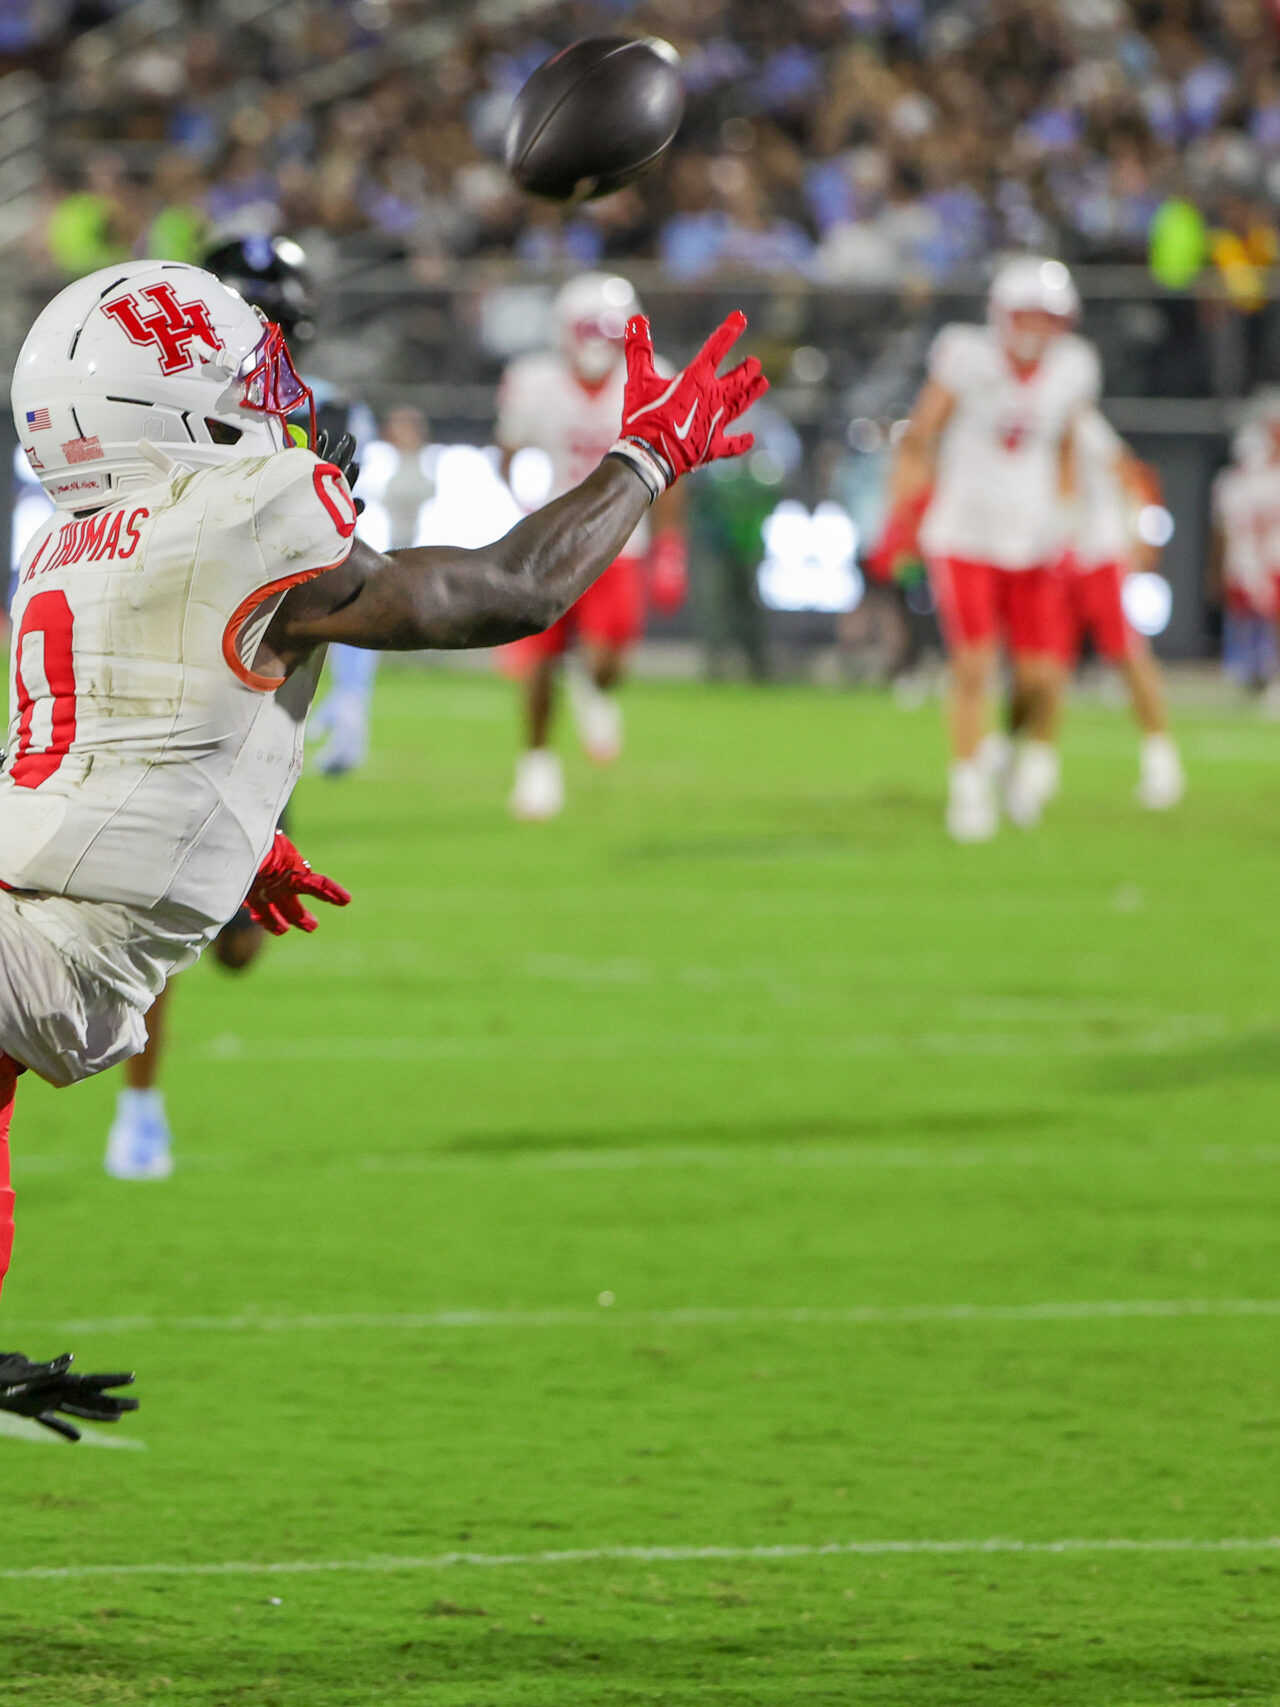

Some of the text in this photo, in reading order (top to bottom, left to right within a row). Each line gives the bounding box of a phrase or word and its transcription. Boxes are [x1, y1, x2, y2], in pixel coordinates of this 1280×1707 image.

[100, 281, 228, 376] UH
[40, 507, 150, 574] THOMAS
[313, 463, 357, 538] 0
[9, 589, 77, 789] 0
